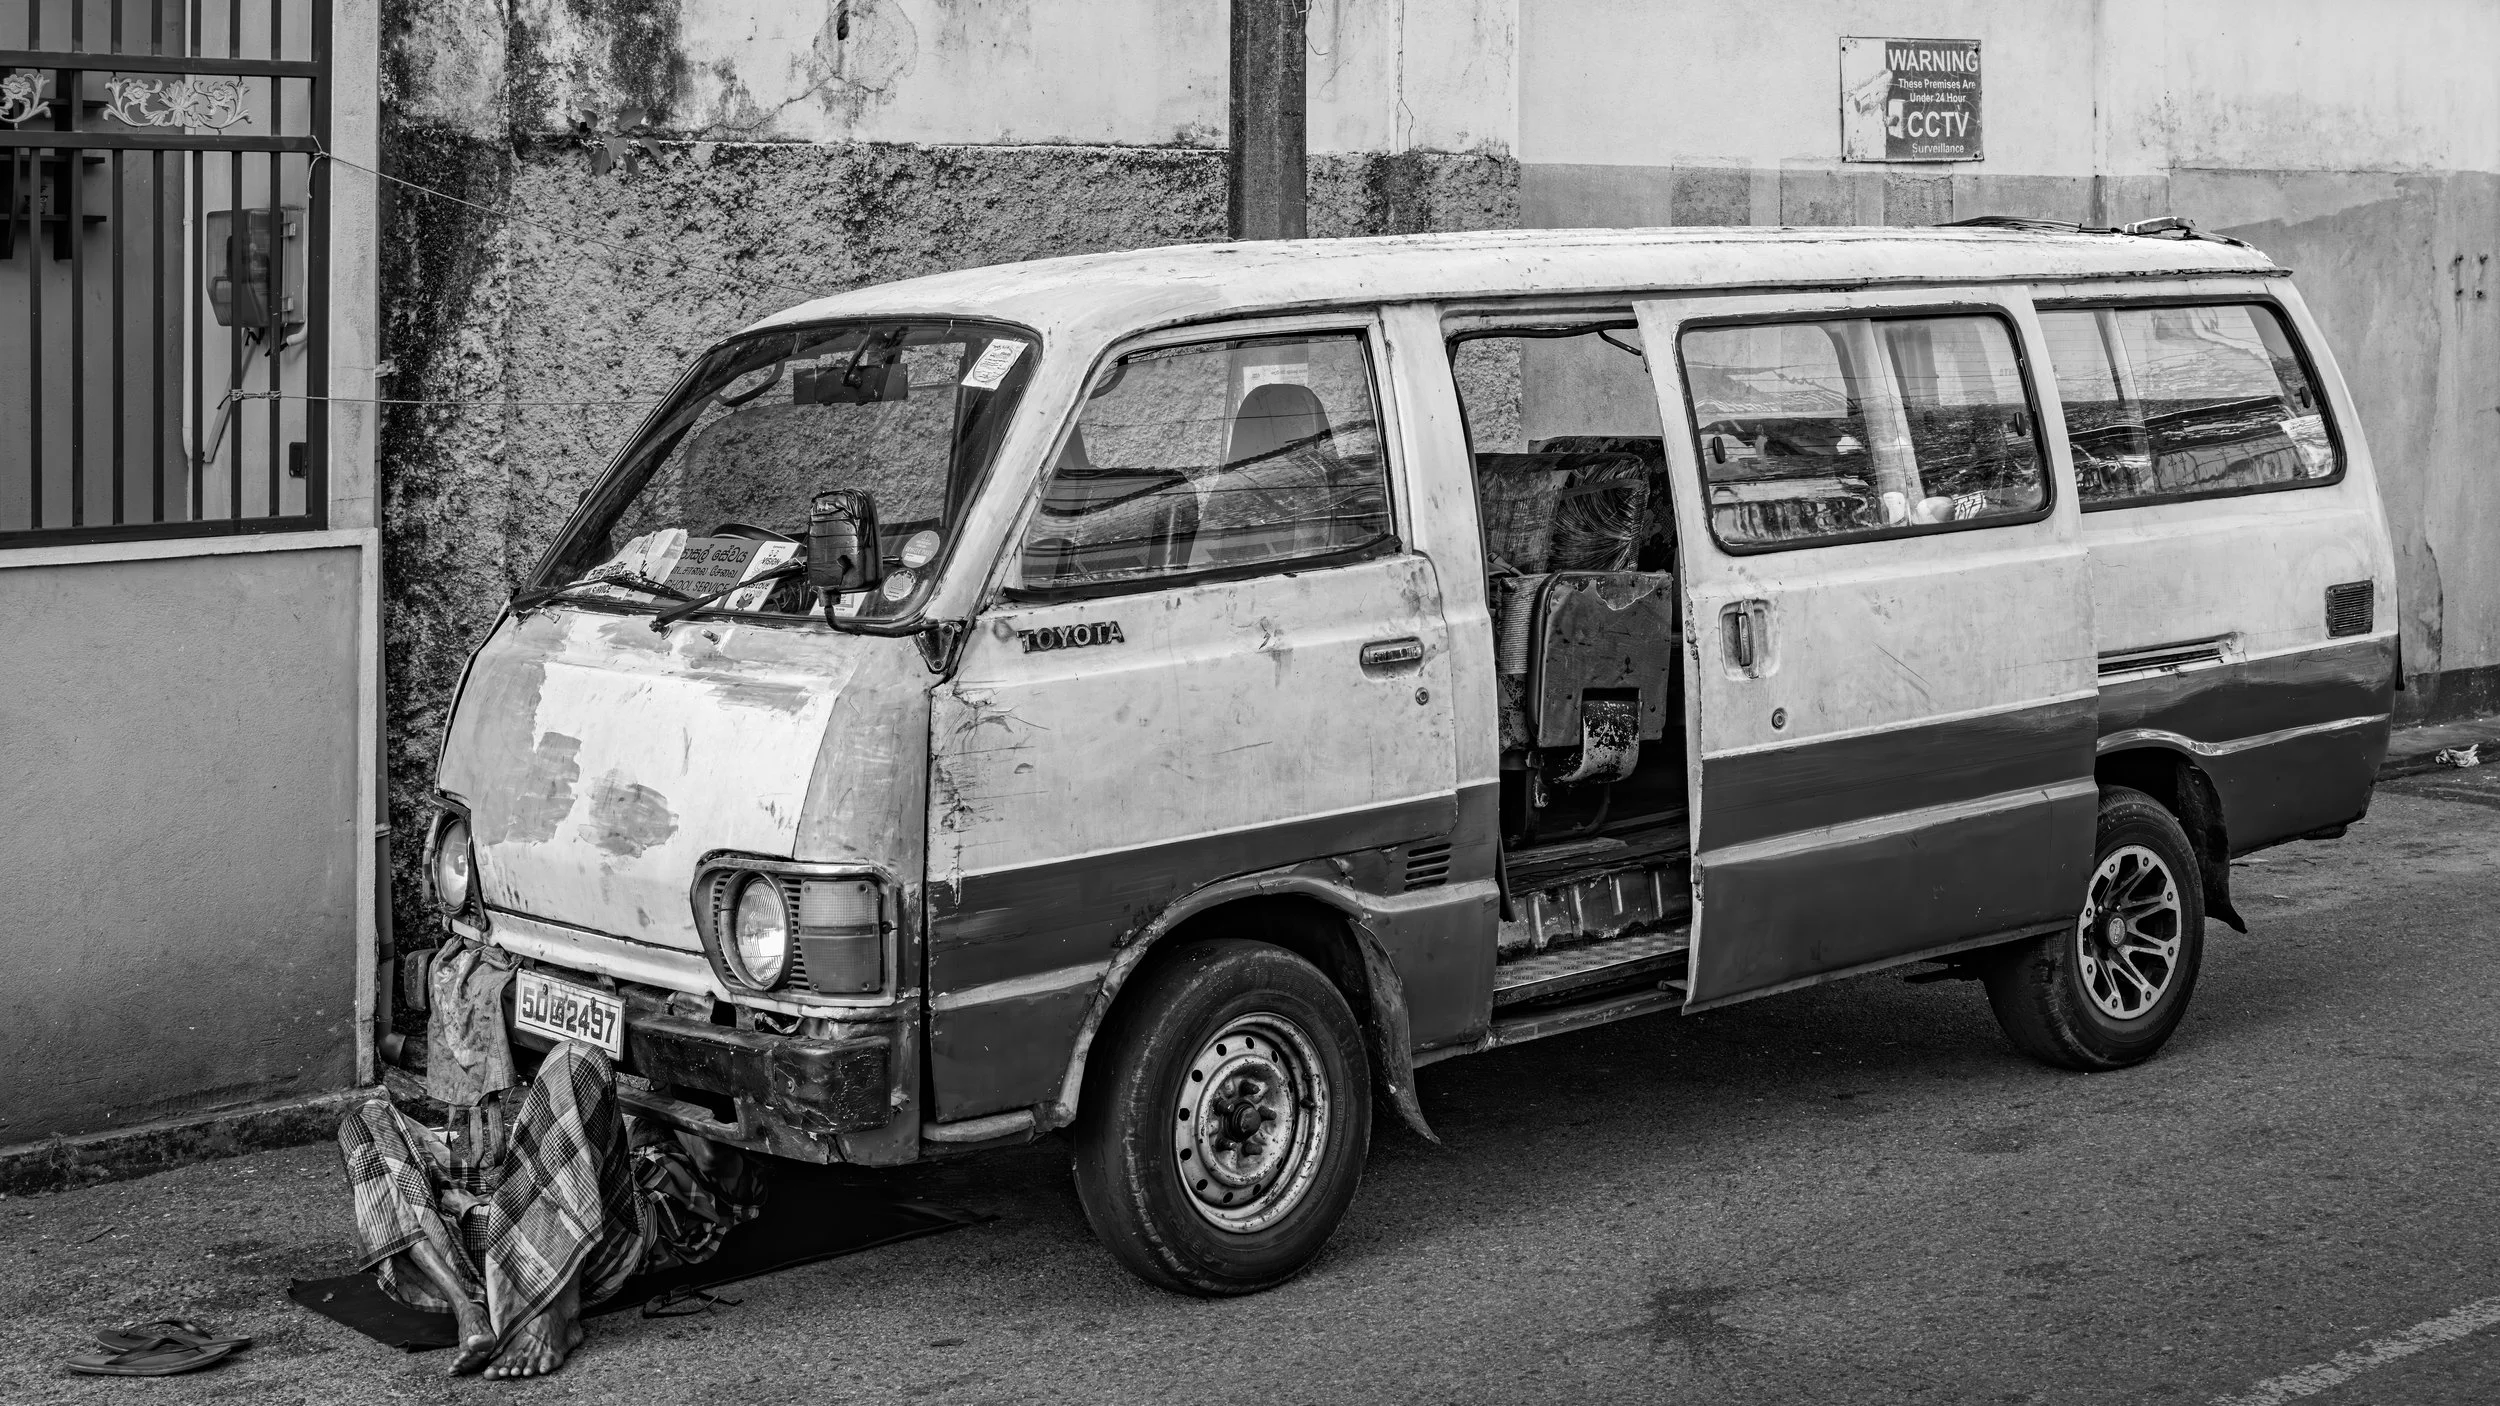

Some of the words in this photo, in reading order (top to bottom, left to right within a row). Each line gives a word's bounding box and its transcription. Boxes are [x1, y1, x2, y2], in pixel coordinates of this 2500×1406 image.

[1888, 48, 1979, 72] WARNING
[1898, 78, 1923, 89] These
[1924, 78, 1961, 89] Premises
[1962, 79, 1976, 89] Are
[1909, 92, 1934, 103] Under
[1935, 93, 1945, 103] 24
[1946, 93, 1967, 103] Hour
[1907, 111, 1970, 138] CCTV
[1911, 142, 1965, 154] Surveillance
[664, 579, 693, 591] CHOOL
[692, 580, 730, 593] SERVICE
[1016, 620, 1125, 654] TOYOTA
